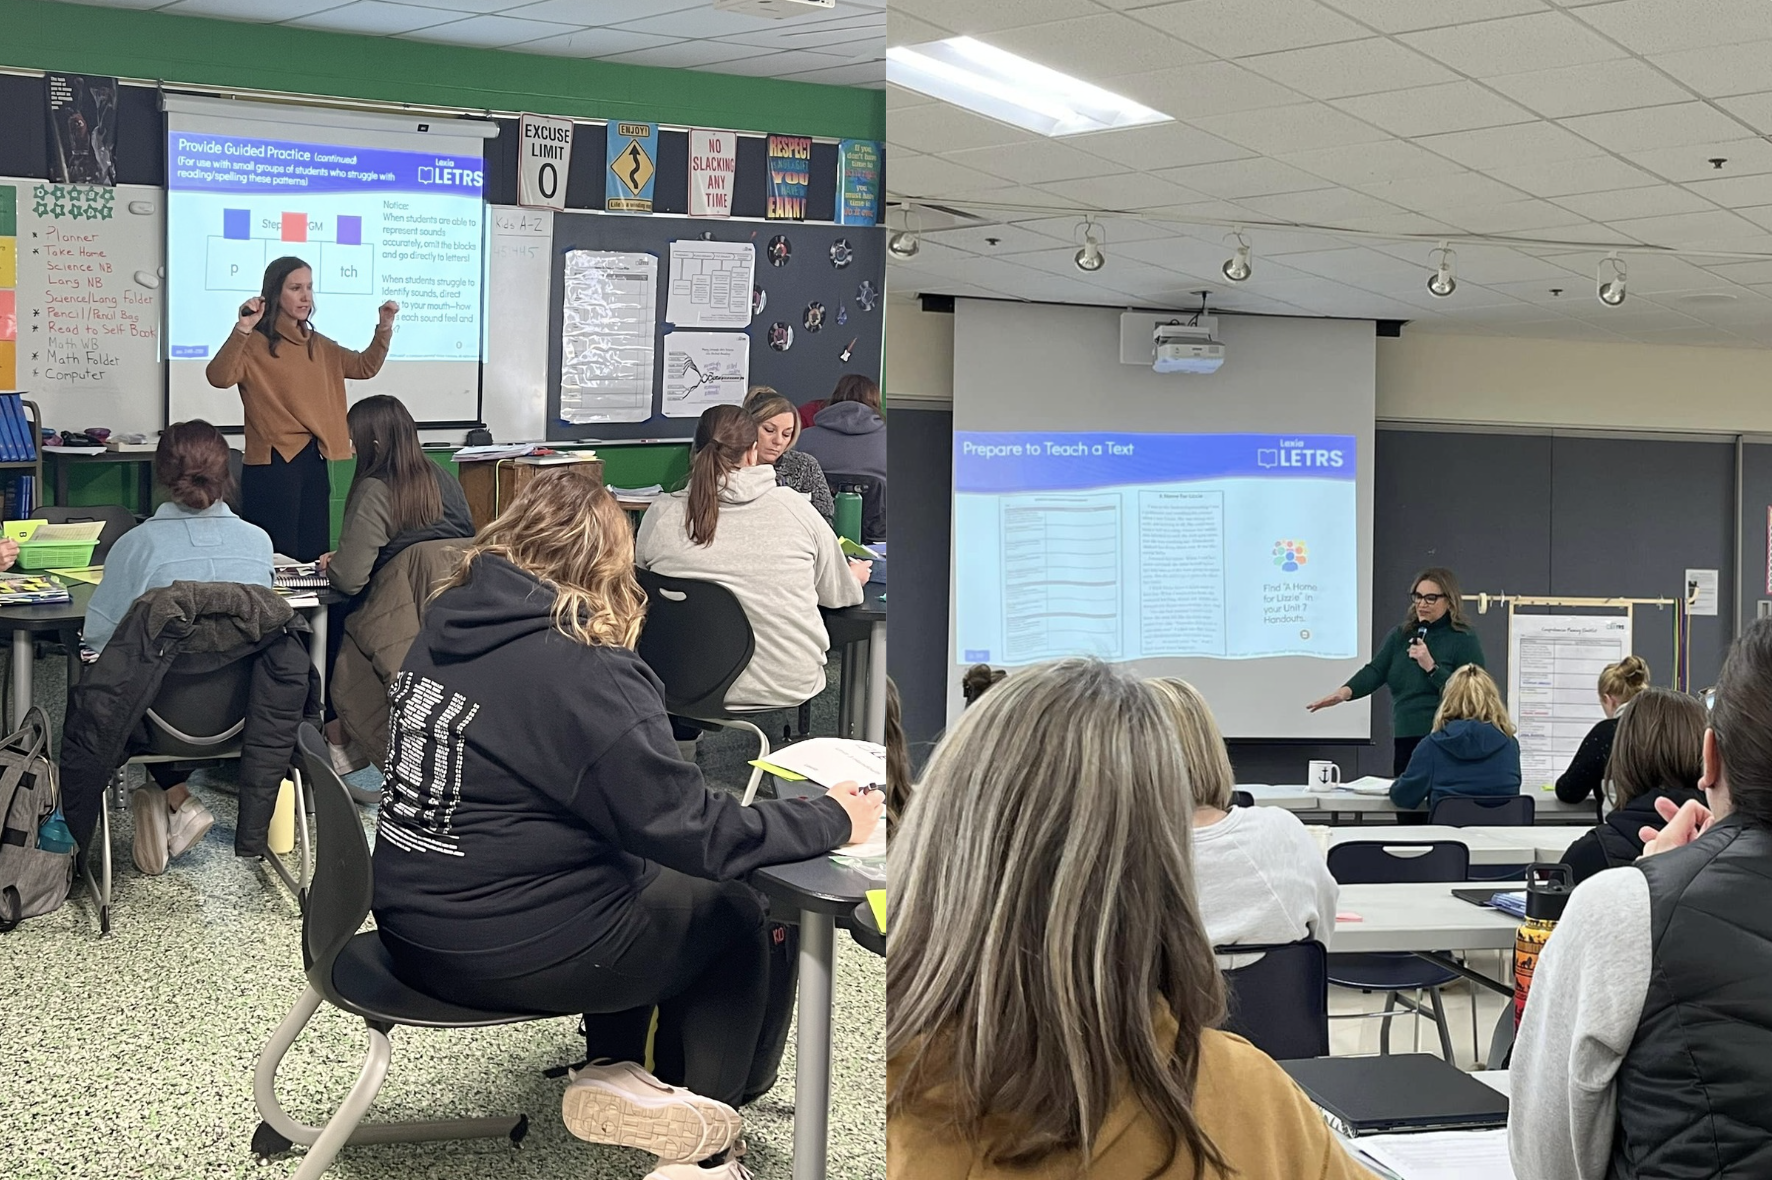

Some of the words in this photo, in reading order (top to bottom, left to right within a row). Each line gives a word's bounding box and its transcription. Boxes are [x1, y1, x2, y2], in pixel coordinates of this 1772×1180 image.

[525, 123, 570, 144] EXCUSE
[620, 125, 648, 135] ENJOY!
[179, 138, 222, 154] Provide
[224, 142, 265, 157] Guided
[267, 146, 311, 161] Practice
[315, 152, 358, 165] (continued)
[531, 143, 565, 160] LIMIT
[709, 139, 722, 154] NO
[769, 135, 811, 160] RESPECT
[177, 155, 195, 167] (For
[196, 159, 211, 168] use
[213, 159, 231, 169] with
[233, 161, 254, 171] small
[256, 164, 284, 174] groups
[286, 164, 294, 174] of
[295, 166, 328, 176] students
[330, 168, 346, 178] who
[347, 169, 378, 182] struggle
[379, 171, 396, 181] with
[436, 158, 454, 167] Lexia
[693, 156, 735, 173] SLACKING
[177, 169, 248, 184] reading/spelling
[249, 173, 271, 184] these
[273, 176, 309, 187] patterns)
[435, 167, 484, 187] LETRS
[538, 162, 558, 199] 0
[707, 174, 726, 190] ANY
[772, 171, 809, 186] YOU
[383, 200, 409, 210] Notice:
[705, 193, 728, 208] TIME
[768, 197, 800, 218] EARN
[262, 218, 282, 231] Step
[307, 221, 323, 231] GM
[383, 212, 404, 222] When
[406, 215, 437, 224] students
[439, 217, 451, 225] are
[452, 217, 467, 226] able
[469, 219, 476, 227] to
[520, 215, 543, 231] A-Z
[46, 226, 99, 242] Planner
[383, 226, 418, 236] represent
[419, 228, 446, 236] sounds
[43, 245, 74, 257] Take
[80, 246, 107, 258] Home
[382, 239, 423, 249] accurately,
[424, 240, 440, 248] omit
[441, 240, 452, 250] the
[453, 241, 476, 250] blocks
[382, 250, 397, 259] and
[399, 251, 408, 261] go
[410, 251, 436, 263] directly
[438, 253, 444, 261] to
[47, 260, 93, 271] Science
[99, 262, 113, 273] NB
[231, 264, 239, 275] p
[340, 265, 358, 278] tch
[48, 274, 80, 289] Lang
[88, 276, 103, 288] NB
[382, 274, 403, 284] When
[405, 276, 435, 286] students
[437, 278, 466, 288] struggle
[45, 290, 117, 309] Science/Lang
[123, 290, 153, 304] Folder
[411, 289, 438, 298] sounds,
[440, 290, 461, 298] direct
[402, 300, 409, 309] to
[410, 302, 426, 310] your
[47, 307, 116, 321] Pencil/Pencil
[120, 310, 139, 323] Bag
[401, 312, 419, 322] each
[420, 313, 443, 323] sound
[445, 313, 458, 322] feel
[459, 314, 473, 323] and
[48, 321, 79, 335] Read
[85, 324, 98, 335] to
[102, 323, 126, 335] Self
[129, 324, 157, 338] Book
[48, 336, 77, 350] Math
[81, 337, 99, 350] WB
[47, 349, 80, 365] Math
[86, 351, 120, 366] Folder
[45, 367, 106, 383] Computer
[963, 441, 1022, 459] Prepare
[1026, 442, 1041, 456] to
[1044, 441, 1088, 456] Teach
[1092, 445, 1102, 456] a
[1105, 441, 1134, 456] Text
[1280, 439, 1304, 447] Lexia
[1280, 449, 1344, 467] LETRS
[1263, 583, 1281, 592] Find
[1293, 583, 1318, 592] Home
[1263, 594, 1275, 603] for
[1305, 594, 1313, 602] in
[1263, 606, 1282, 614] your
[1284, 604, 1300, 612] Unit
[1302, 603, 1308, 612] 7
[1264, 615, 1306, 624] Handouts.
